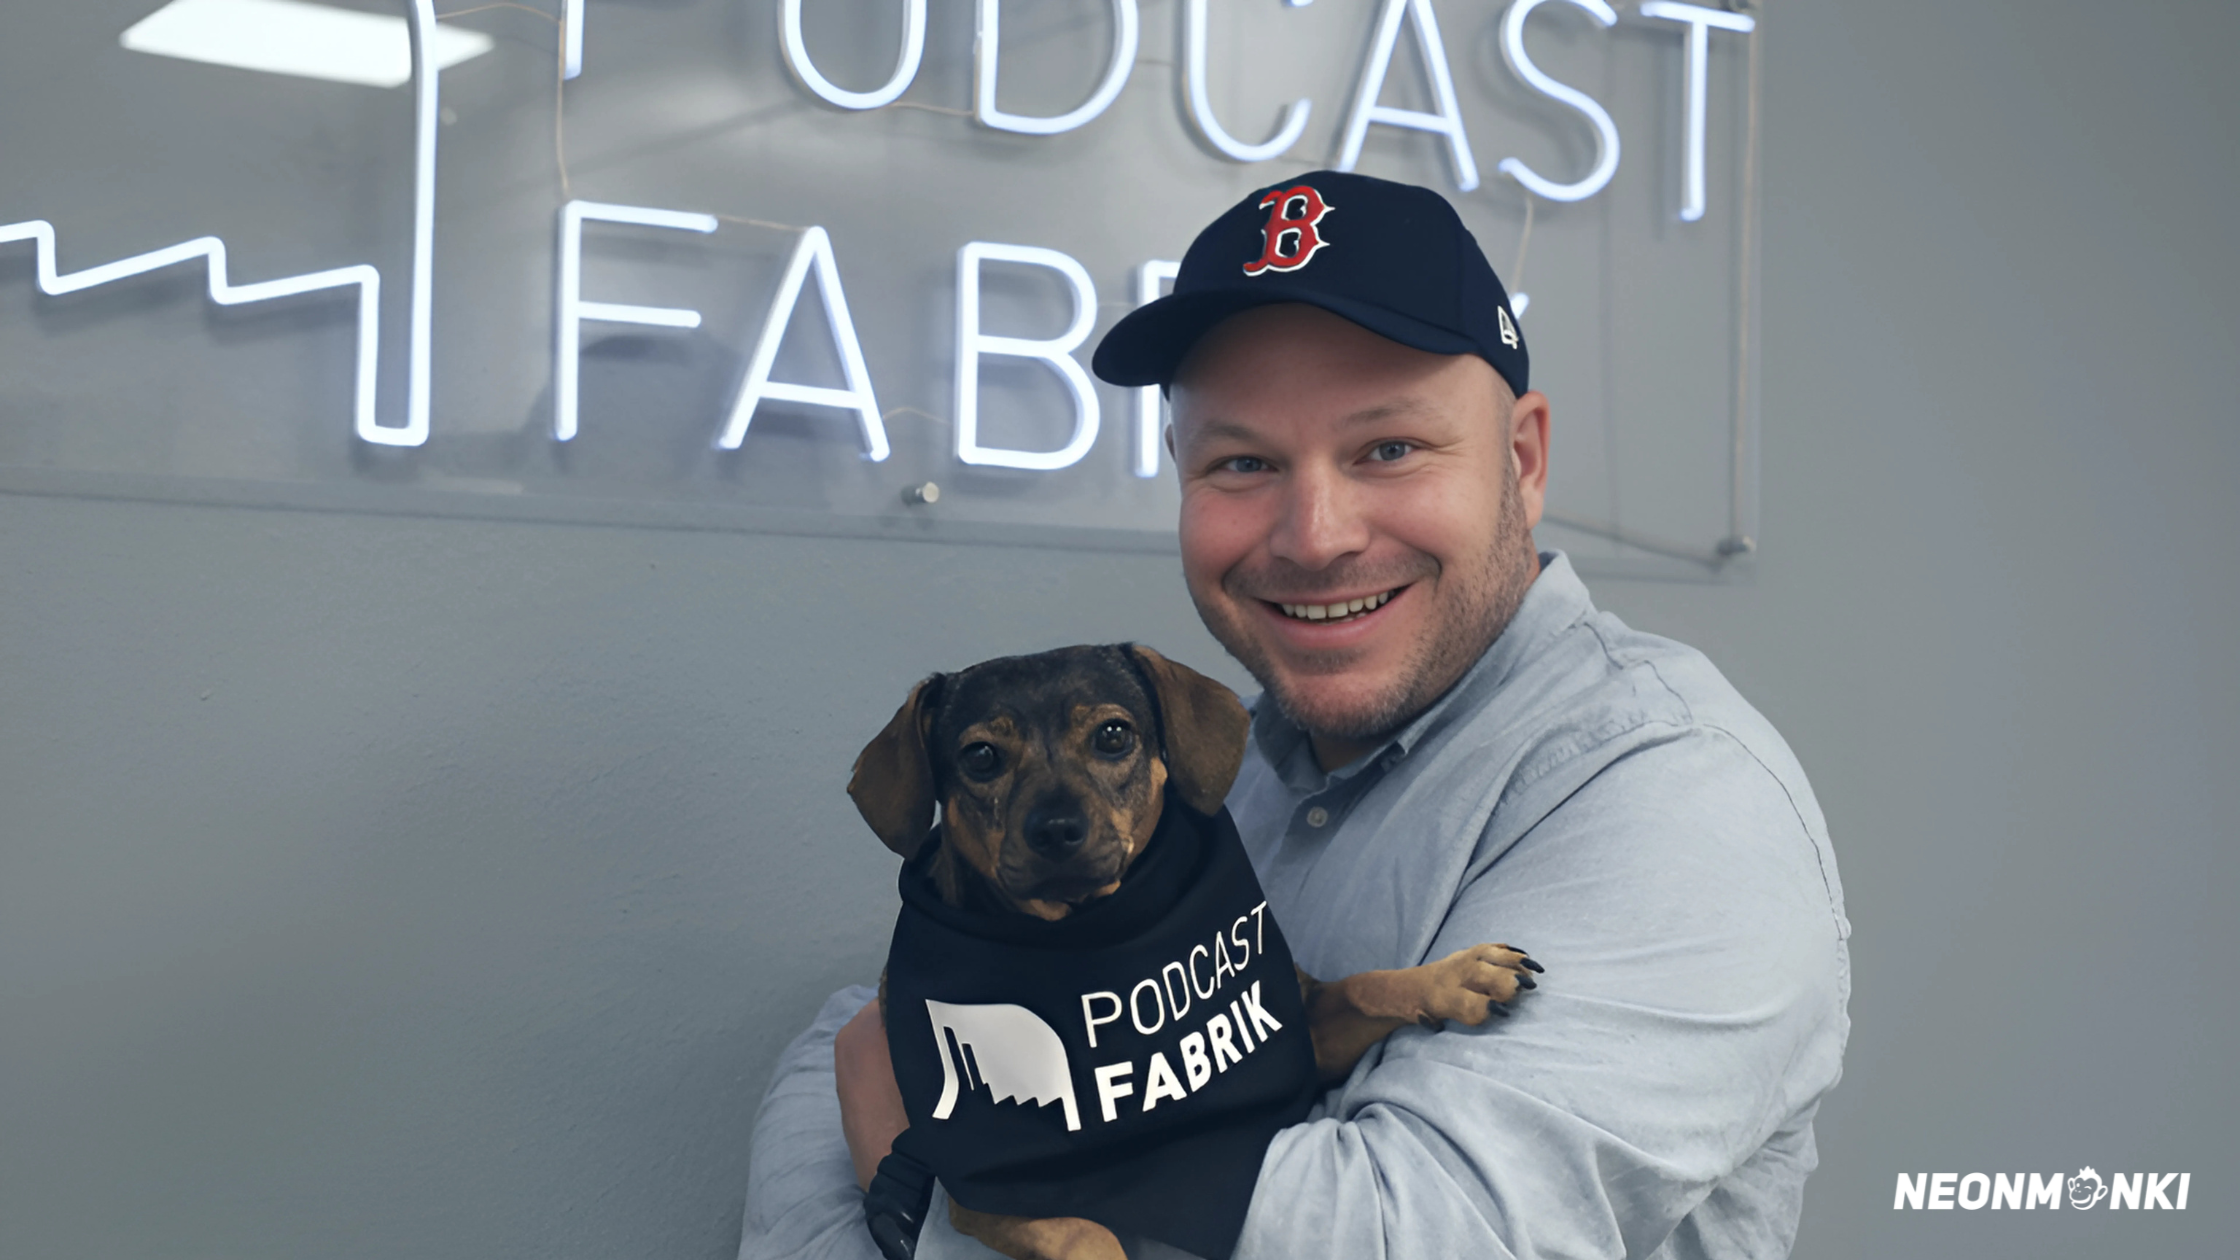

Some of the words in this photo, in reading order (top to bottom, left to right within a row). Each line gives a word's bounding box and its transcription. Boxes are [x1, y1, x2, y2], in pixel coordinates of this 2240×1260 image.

[1243, 185, 1335, 276] B
[553, 200, 1529, 478] FAB
[1081, 900, 1267, 1048] PODCAST
[1094, 980, 1283, 1122] FABRIK
